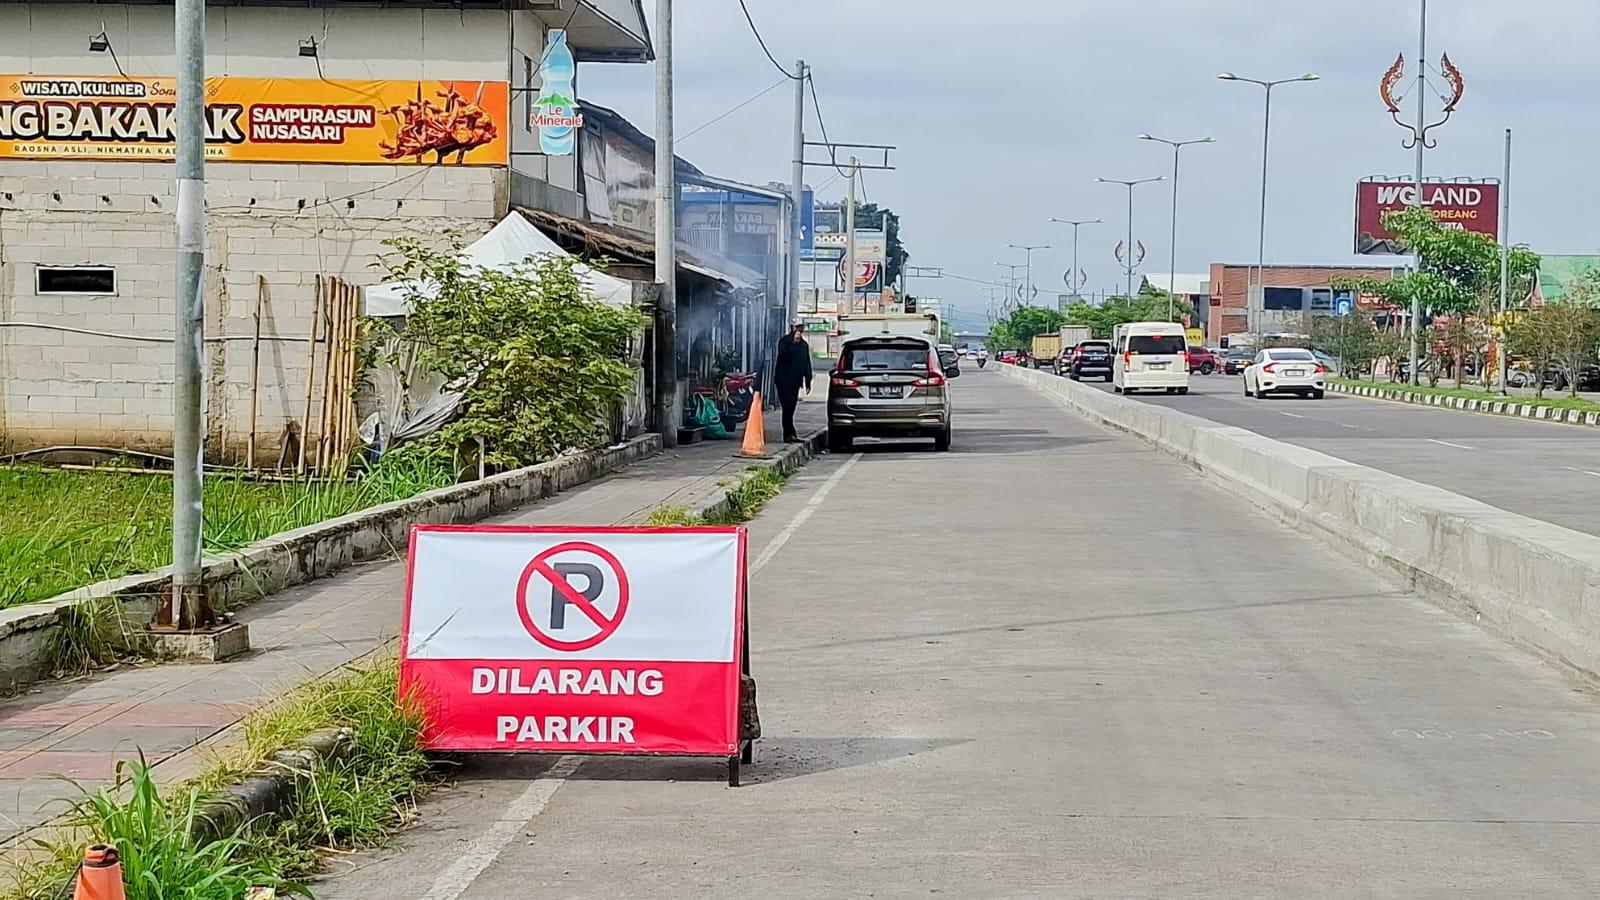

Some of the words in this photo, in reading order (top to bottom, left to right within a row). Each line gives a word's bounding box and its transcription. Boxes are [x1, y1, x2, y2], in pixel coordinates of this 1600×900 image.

[22, 82, 79, 95] WISATA
[82, 82, 145, 96] KULINER
[252, 107, 372, 124] SAMPURASUN
[548, 103, 563, 116] Le
[47, 105, 243, 140] BAKAKK
[252, 124, 341, 140] NUSASARI
[1432, 209, 1478, 219] OREANG
[471, 667, 664, 696] DILARANG
[496, 716, 635, 744] PARKIR
